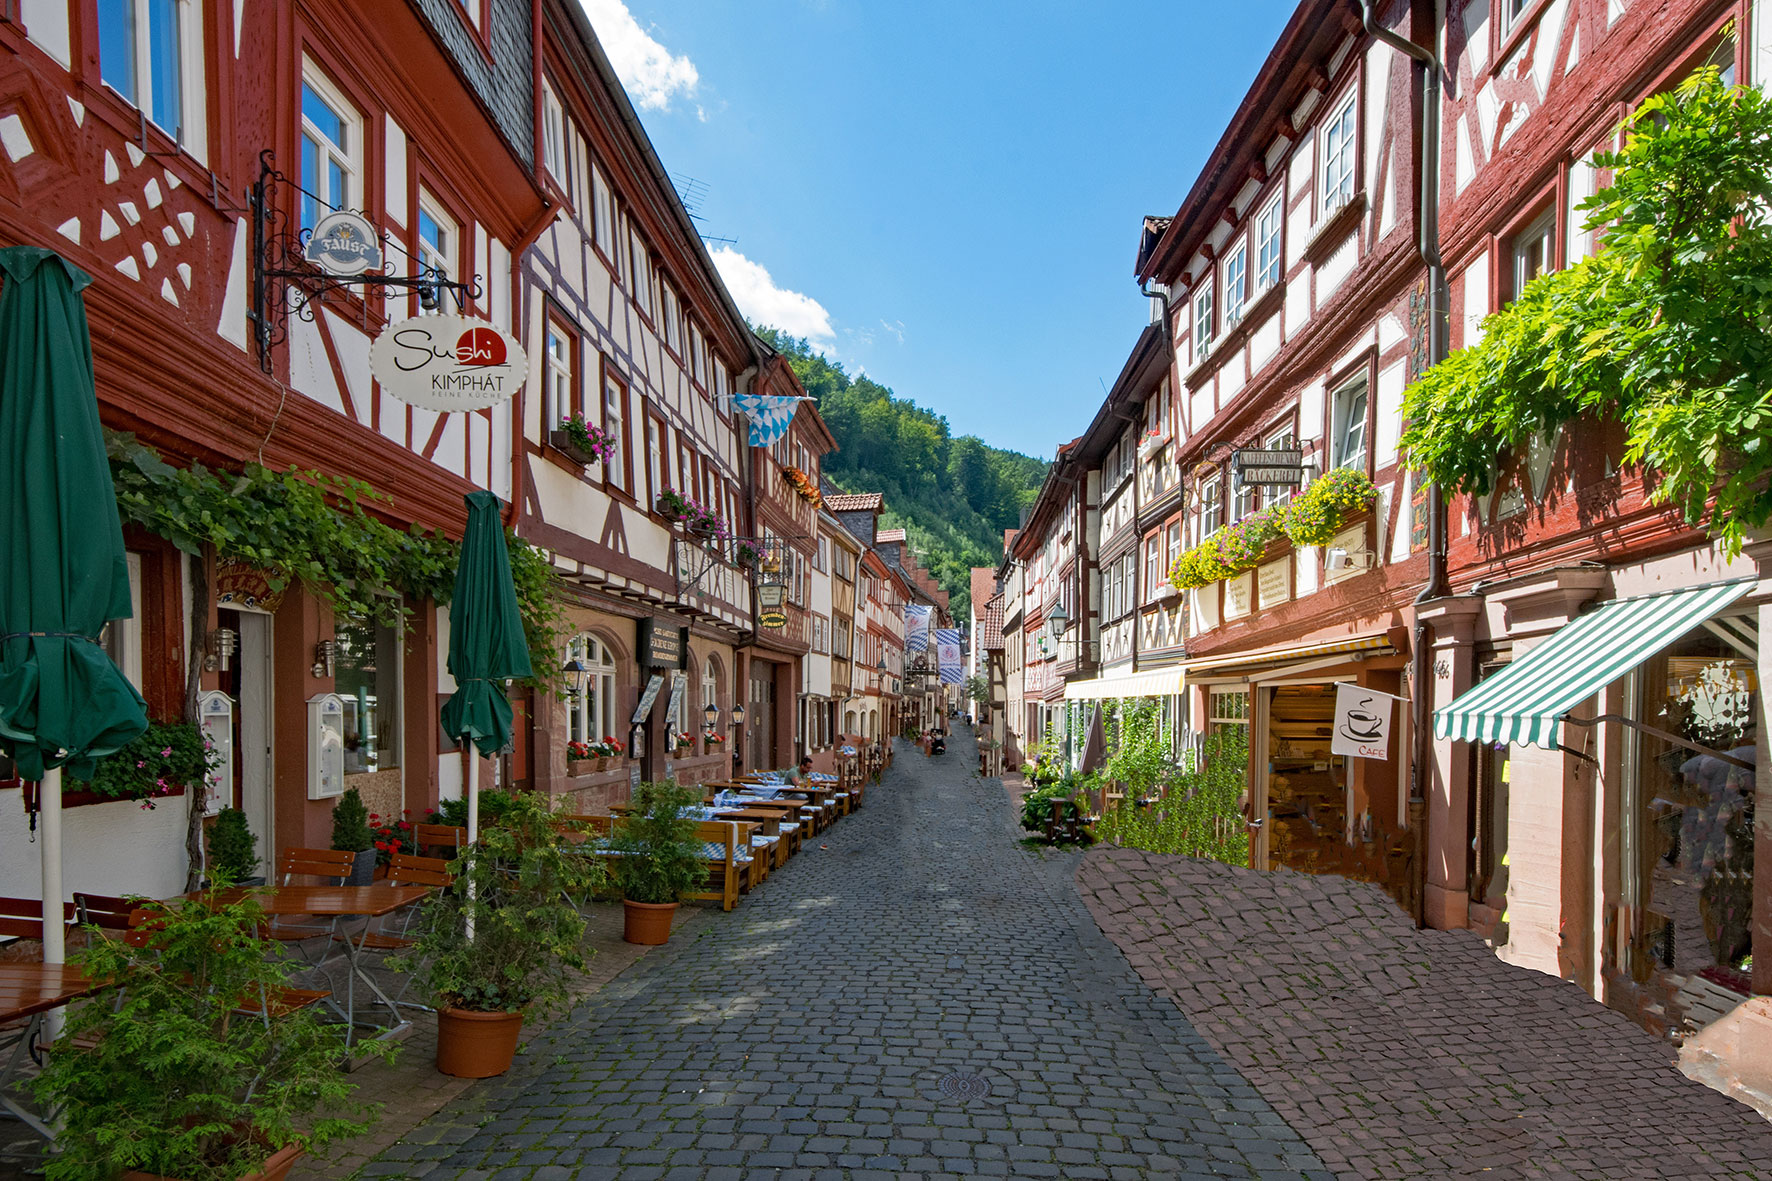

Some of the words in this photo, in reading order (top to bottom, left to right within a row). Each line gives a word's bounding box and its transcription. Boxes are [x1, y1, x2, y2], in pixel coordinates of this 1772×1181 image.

[320, 238, 370, 256] FAUST
[392, 328, 492, 372] Sushi
[431, 373, 504, 391] KIMPHÁT
[1247, 469, 1297, 482] BÄCKEREI
